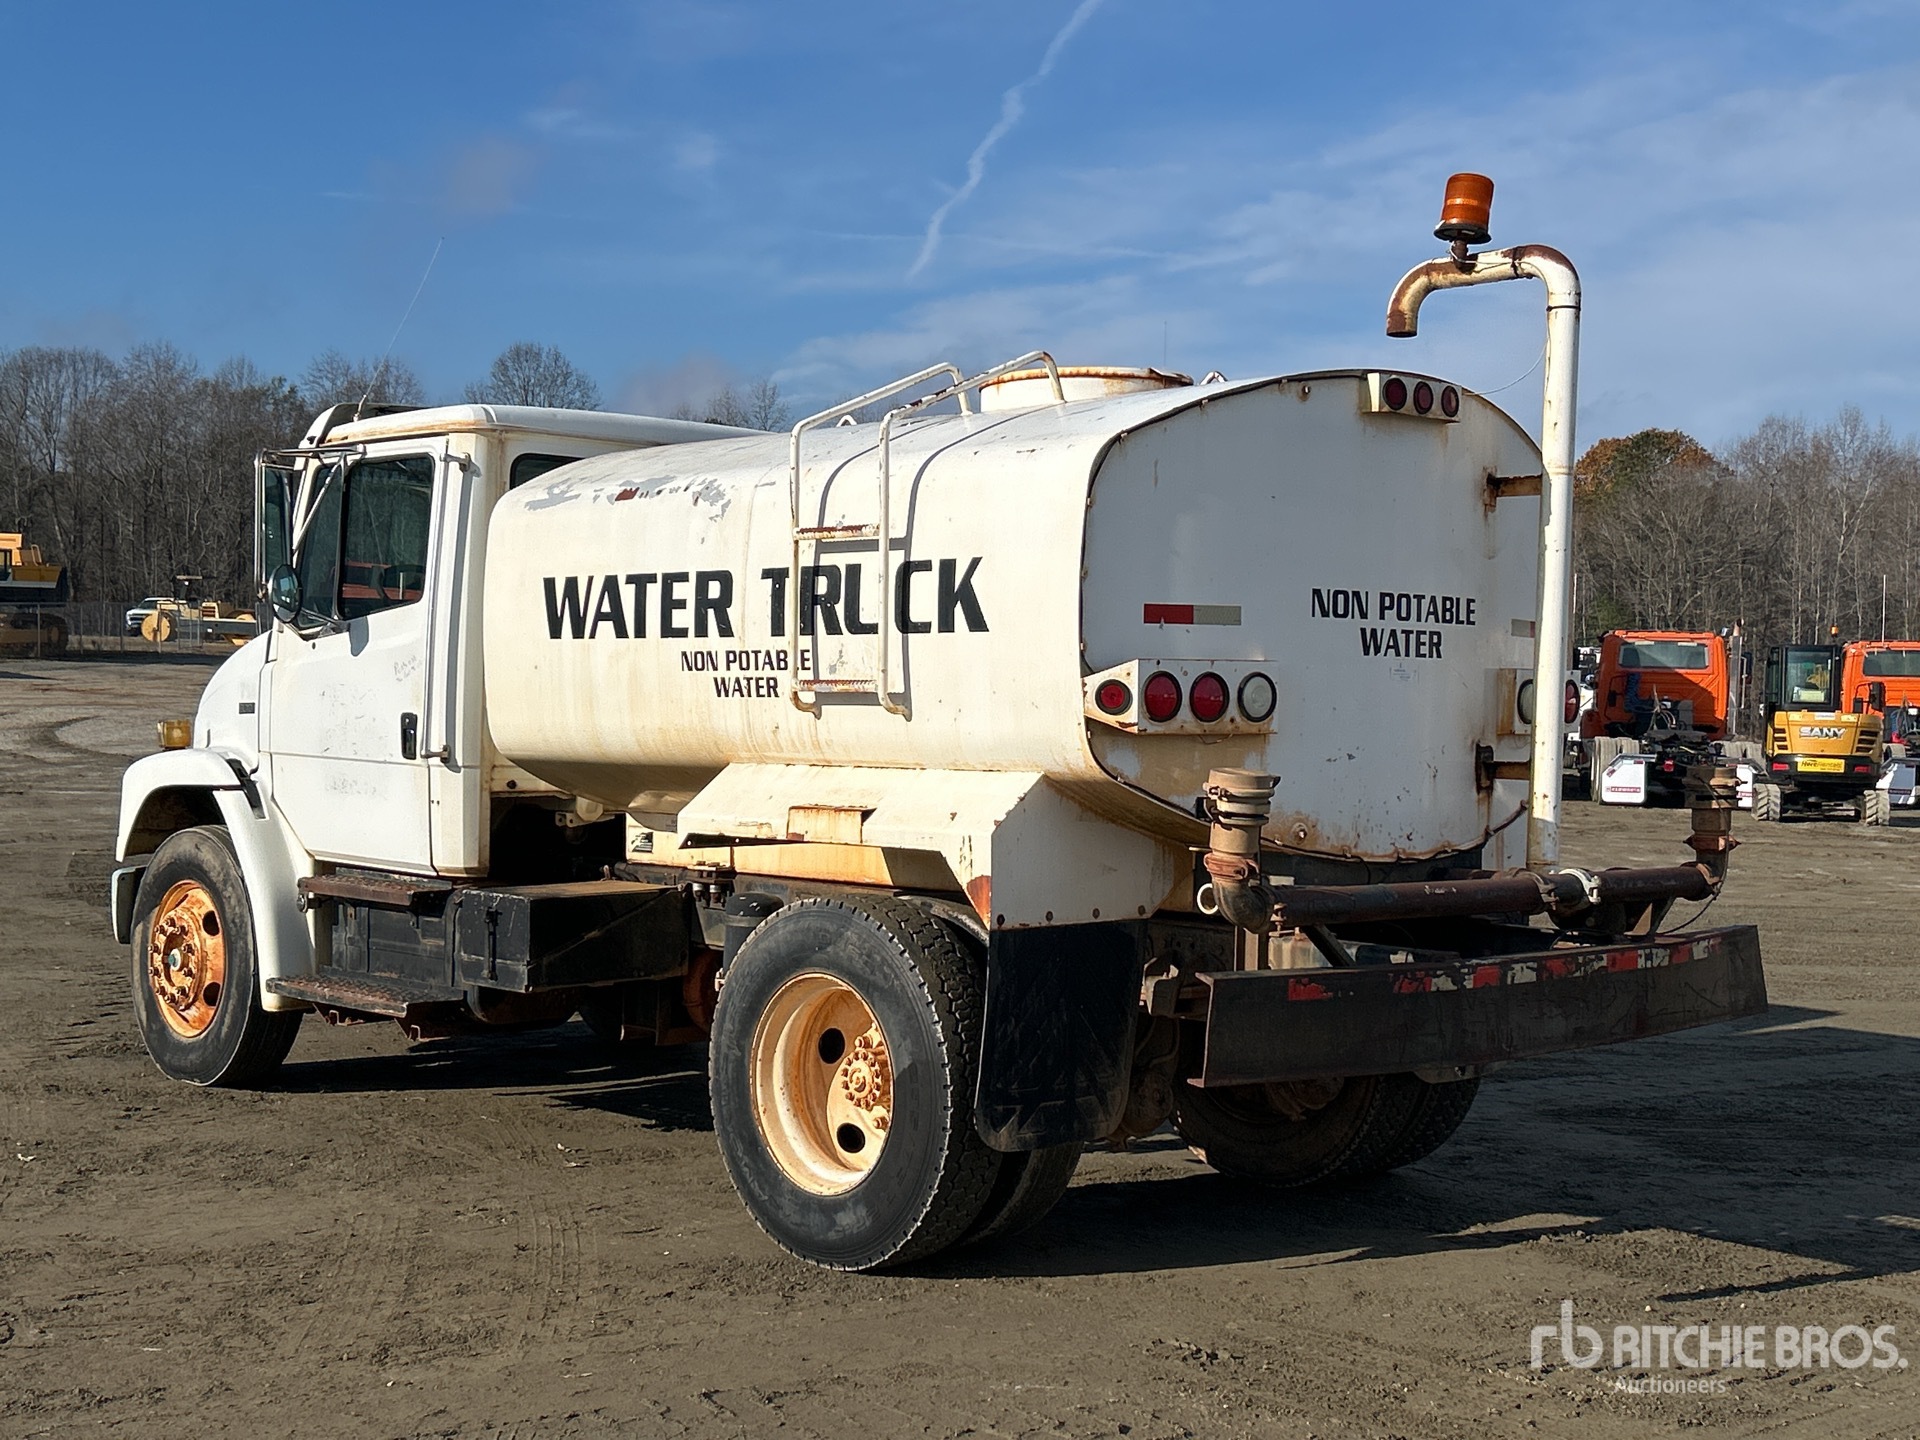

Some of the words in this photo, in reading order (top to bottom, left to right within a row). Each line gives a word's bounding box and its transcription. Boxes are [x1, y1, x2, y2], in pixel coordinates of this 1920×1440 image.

[543, 569, 735, 639] WATER
[1310, 588, 1369, 620] NON
[1378, 592, 1476, 626] POTABLE
[1359, 627, 1442, 659] WATER
[680, 649, 719, 672] NON
[725, 648, 812, 671] POTABE
[713, 676, 780, 698] WATER
[1799, 726, 1846, 738] SANY
